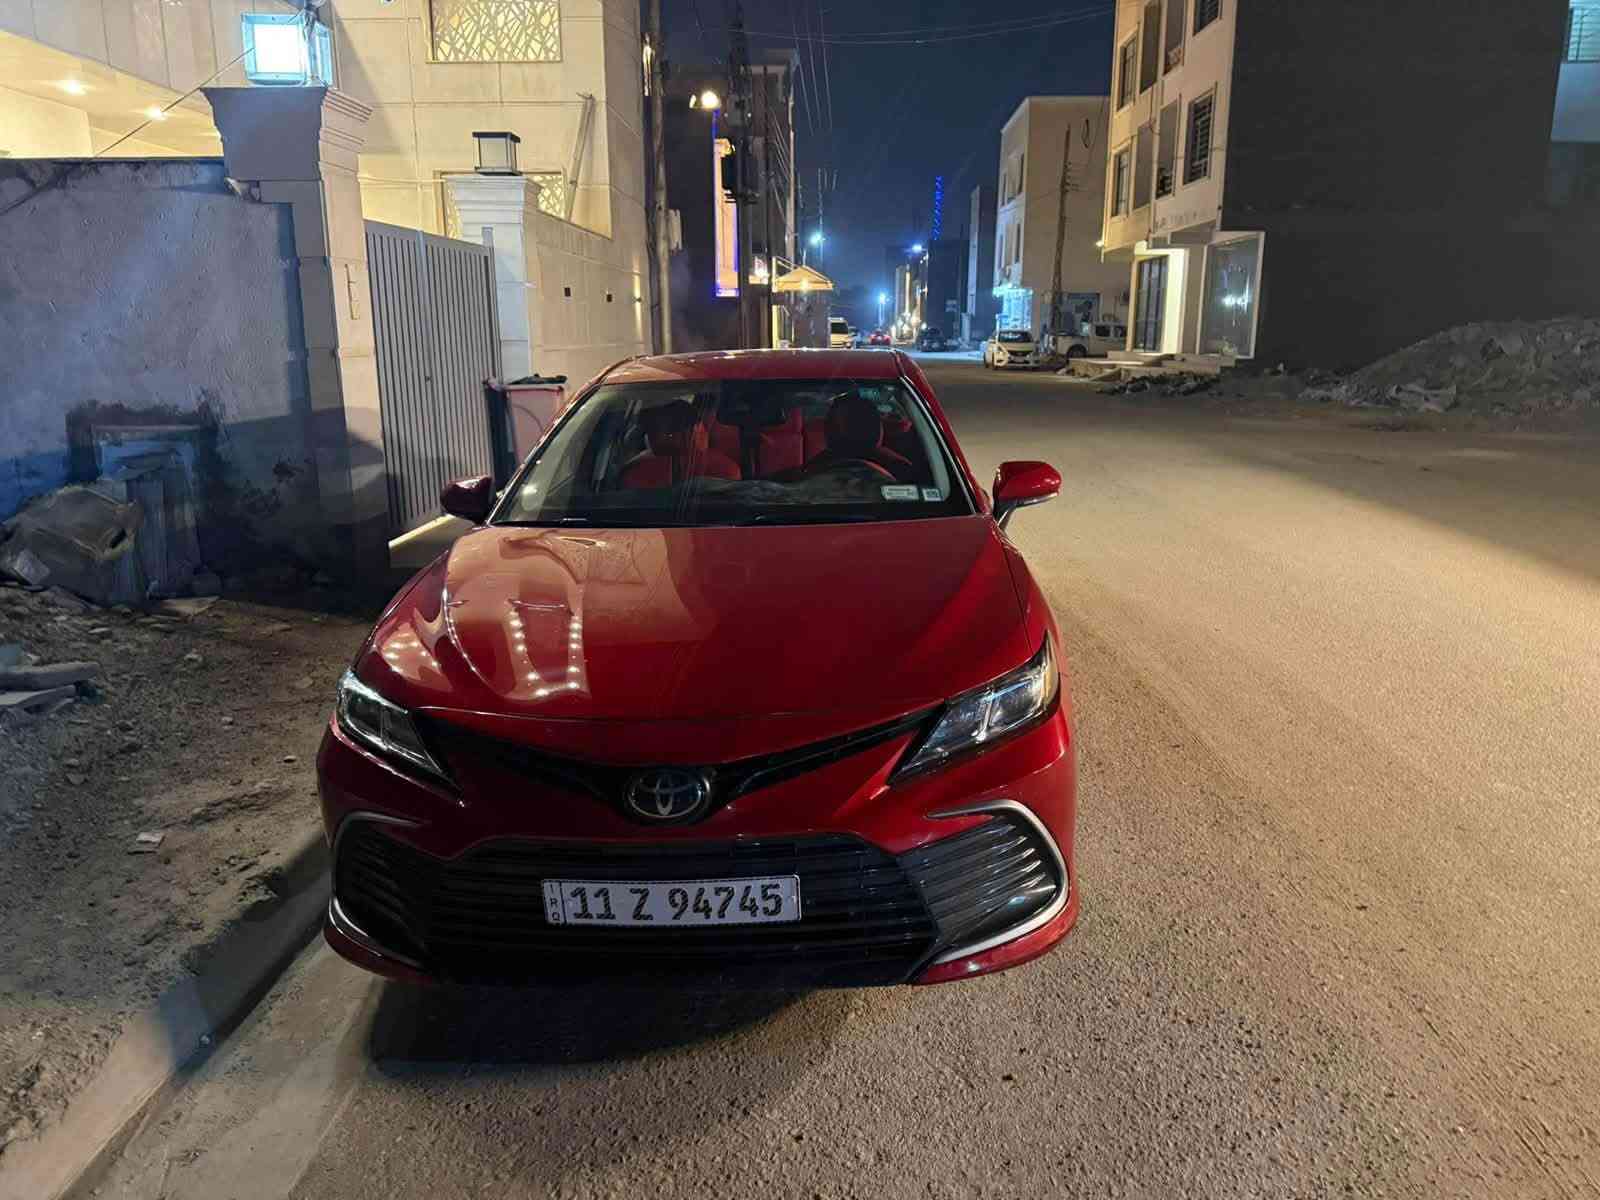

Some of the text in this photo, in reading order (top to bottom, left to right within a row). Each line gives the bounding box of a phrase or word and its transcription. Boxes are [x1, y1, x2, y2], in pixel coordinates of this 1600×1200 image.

[550, 884, 560, 921] IRQ
[570, 883, 783, 920] 11 Z 94745
